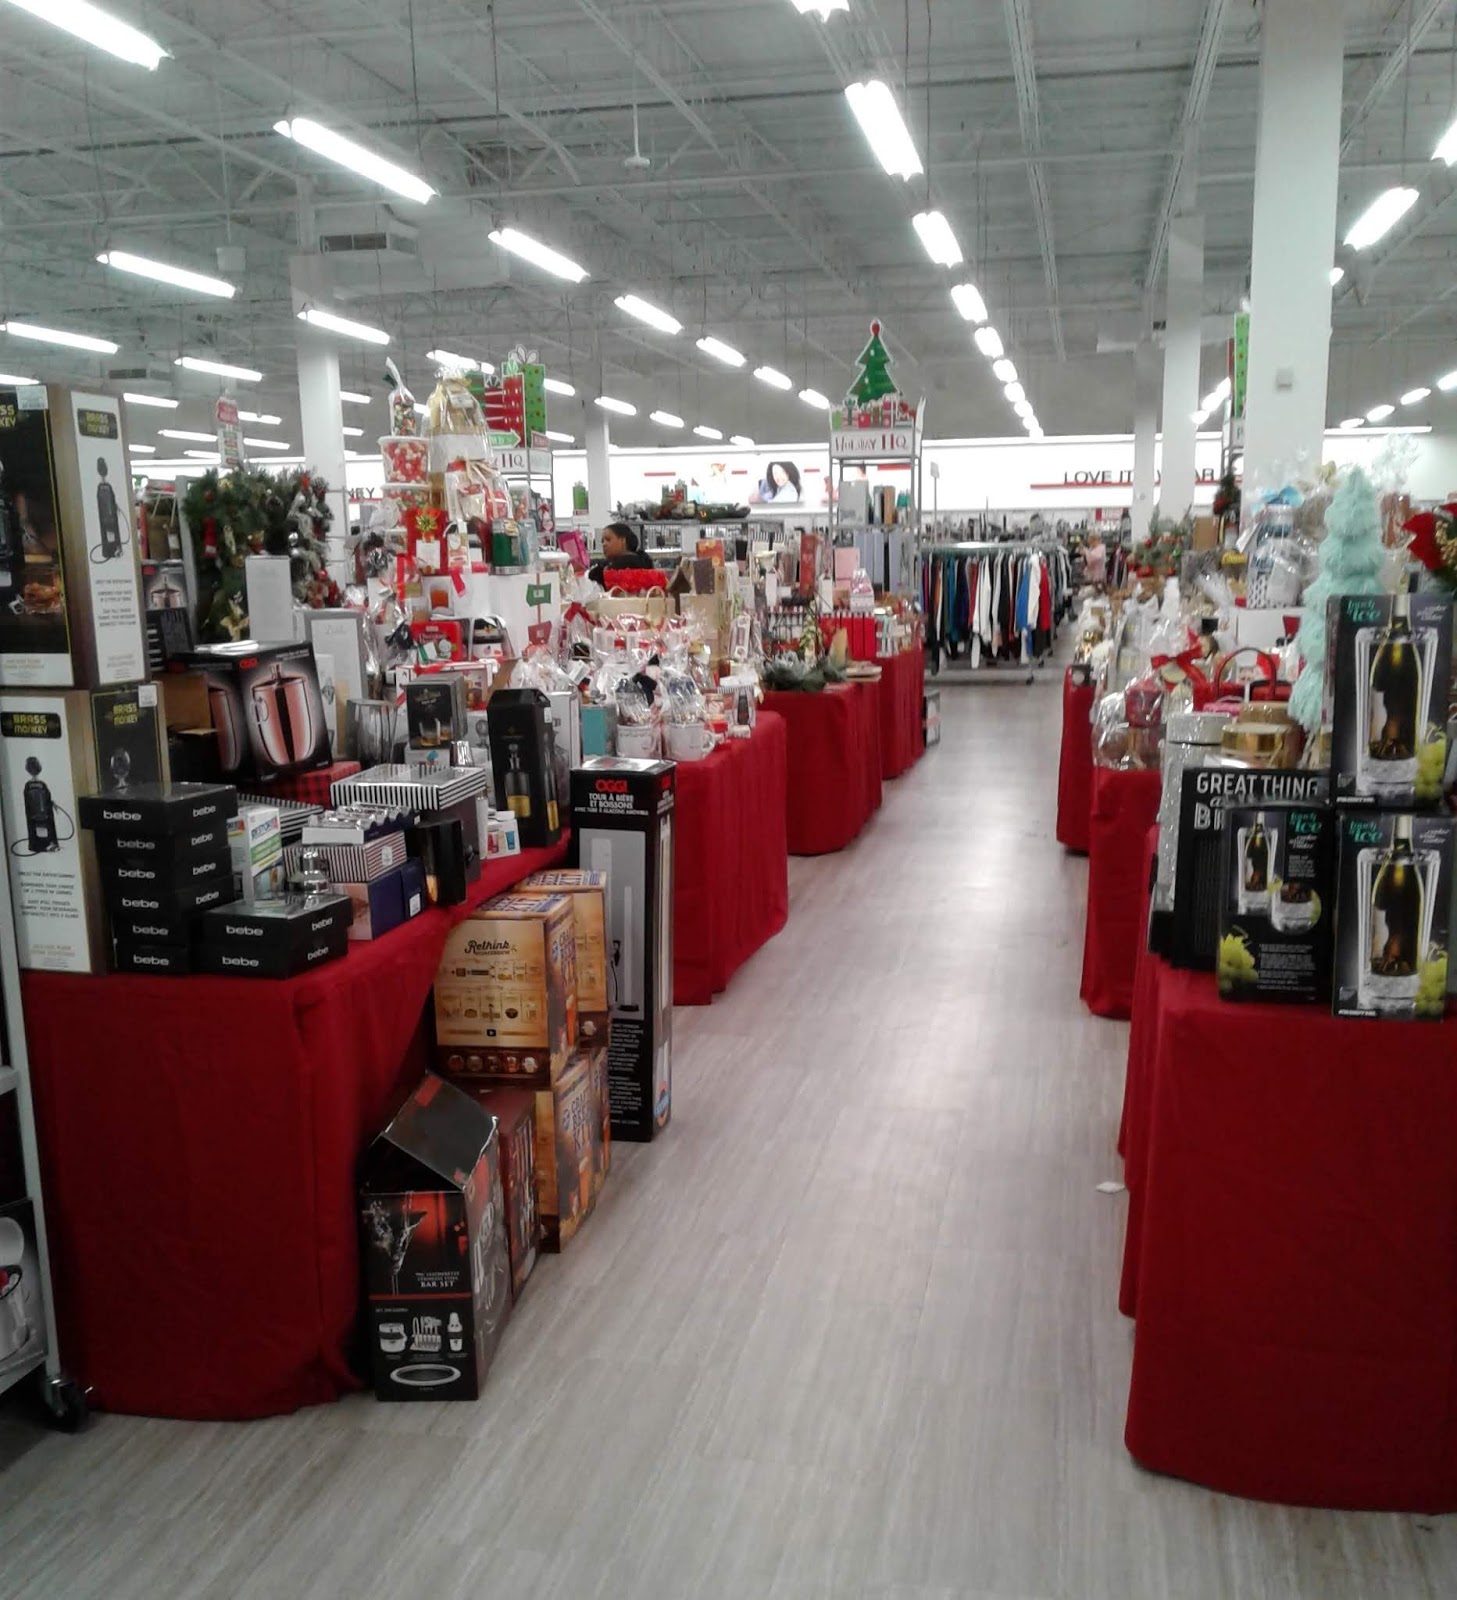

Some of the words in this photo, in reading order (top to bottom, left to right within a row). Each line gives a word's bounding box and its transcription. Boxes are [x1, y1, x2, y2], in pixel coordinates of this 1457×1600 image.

[881, 433, 907, 450] HQ
[502, 453, 525, 468] HQ
[1064, 471, 1112, 485] LOVE
[13, 714, 47, 724] BRASS
[14, 724, 48, 734] MONKEY
[1196, 772, 1258, 796] GREAT
[589, 793, 608, 801] TOUR
[193, 804, 216, 818] bebe
[599, 801, 634, 810] BOISSONS
[103, 810, 142, 821] bebe
[117, 839, 155, 850] bebe
[192, 832, 214, 846] bebe
[118, 868, 156, 880] bebe
[193, 862, 217, 876] bebe
[122, 897, 159, 909] bebe
[196, 891, 220, 905] bebe
[132, 924, 169, 936] bebe
[312, 917, 334, 931] bebe
[226, 925, 264, 937] bebe
[464, 940, 511, 954] Rethink
[308, 946, 329, 961] bebe
[133, 954, 170, 966] bebe
[222, 956, 260, 968] bebe
[439, 1280, 455, 1288] SET
